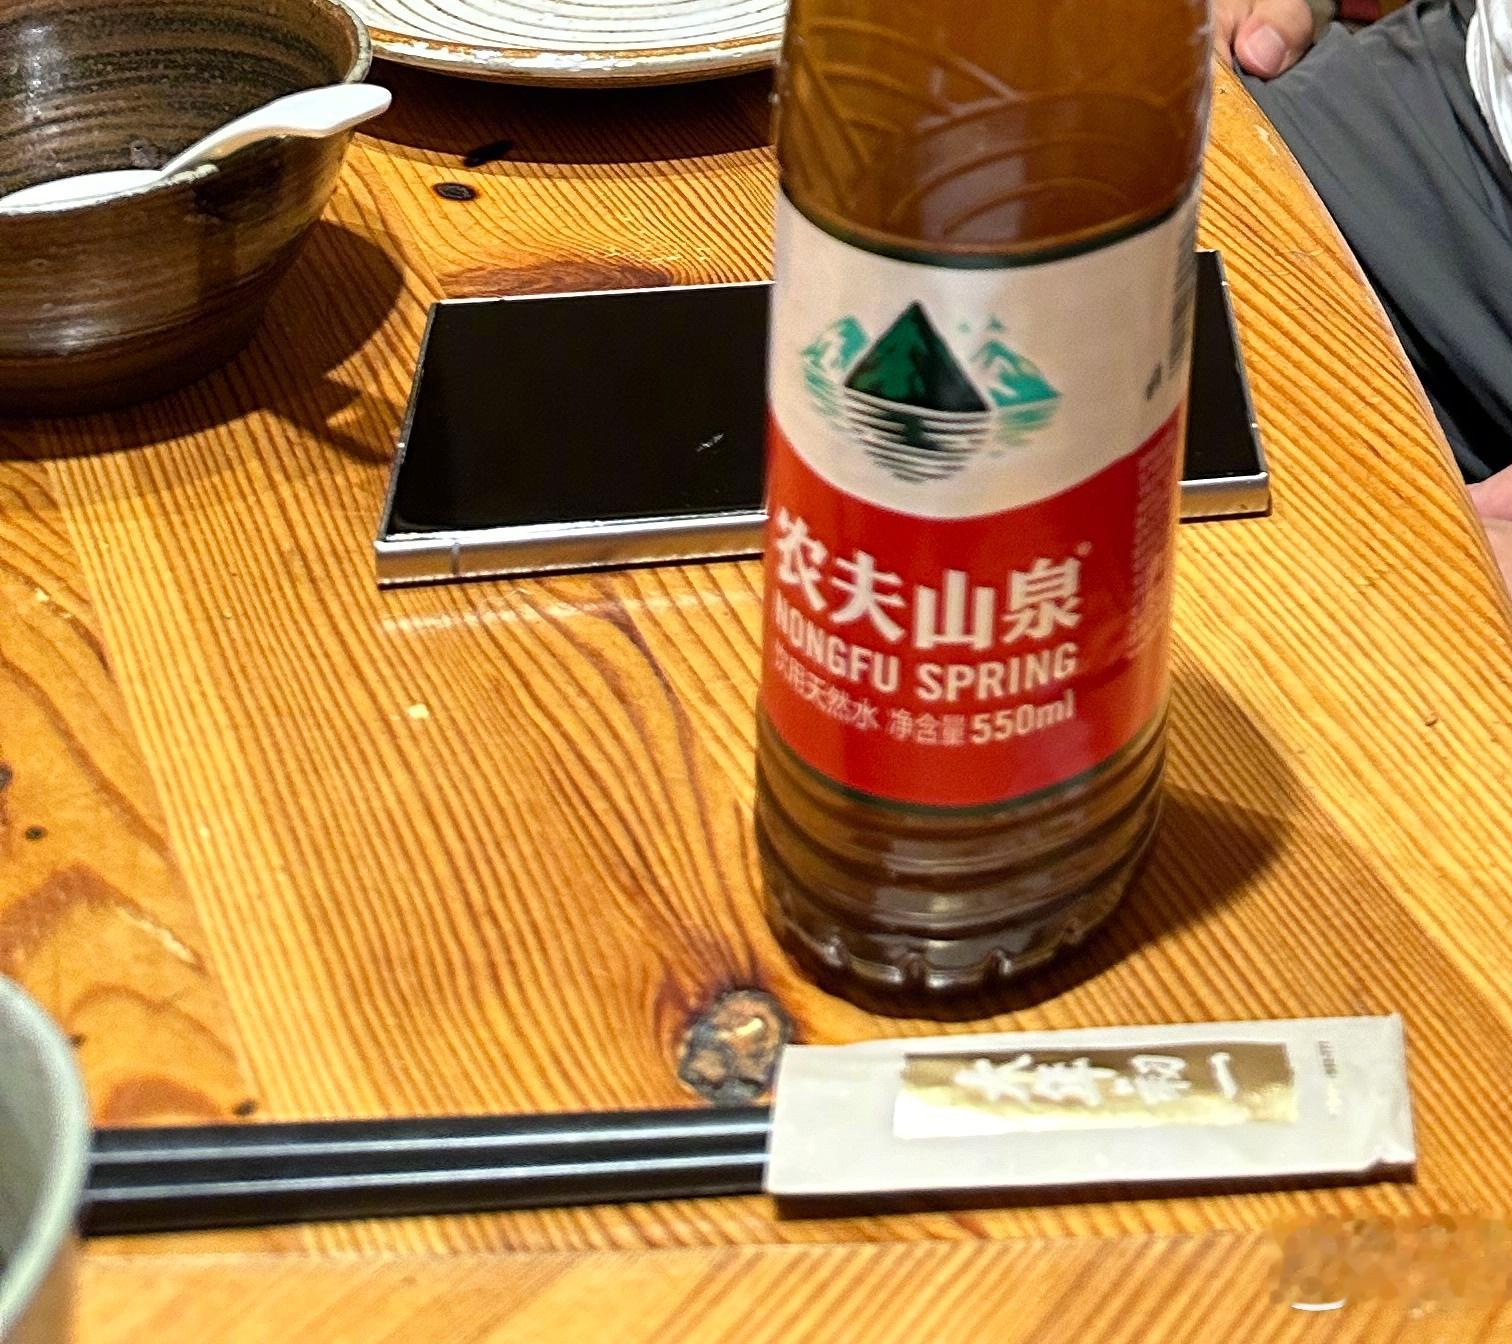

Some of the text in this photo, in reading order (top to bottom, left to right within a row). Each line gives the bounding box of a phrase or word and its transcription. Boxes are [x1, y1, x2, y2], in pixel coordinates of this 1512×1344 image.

[775, 506, 1084, 652] 农夫山泉
[774, 587, 1080, 704] NONGFU SPRING
